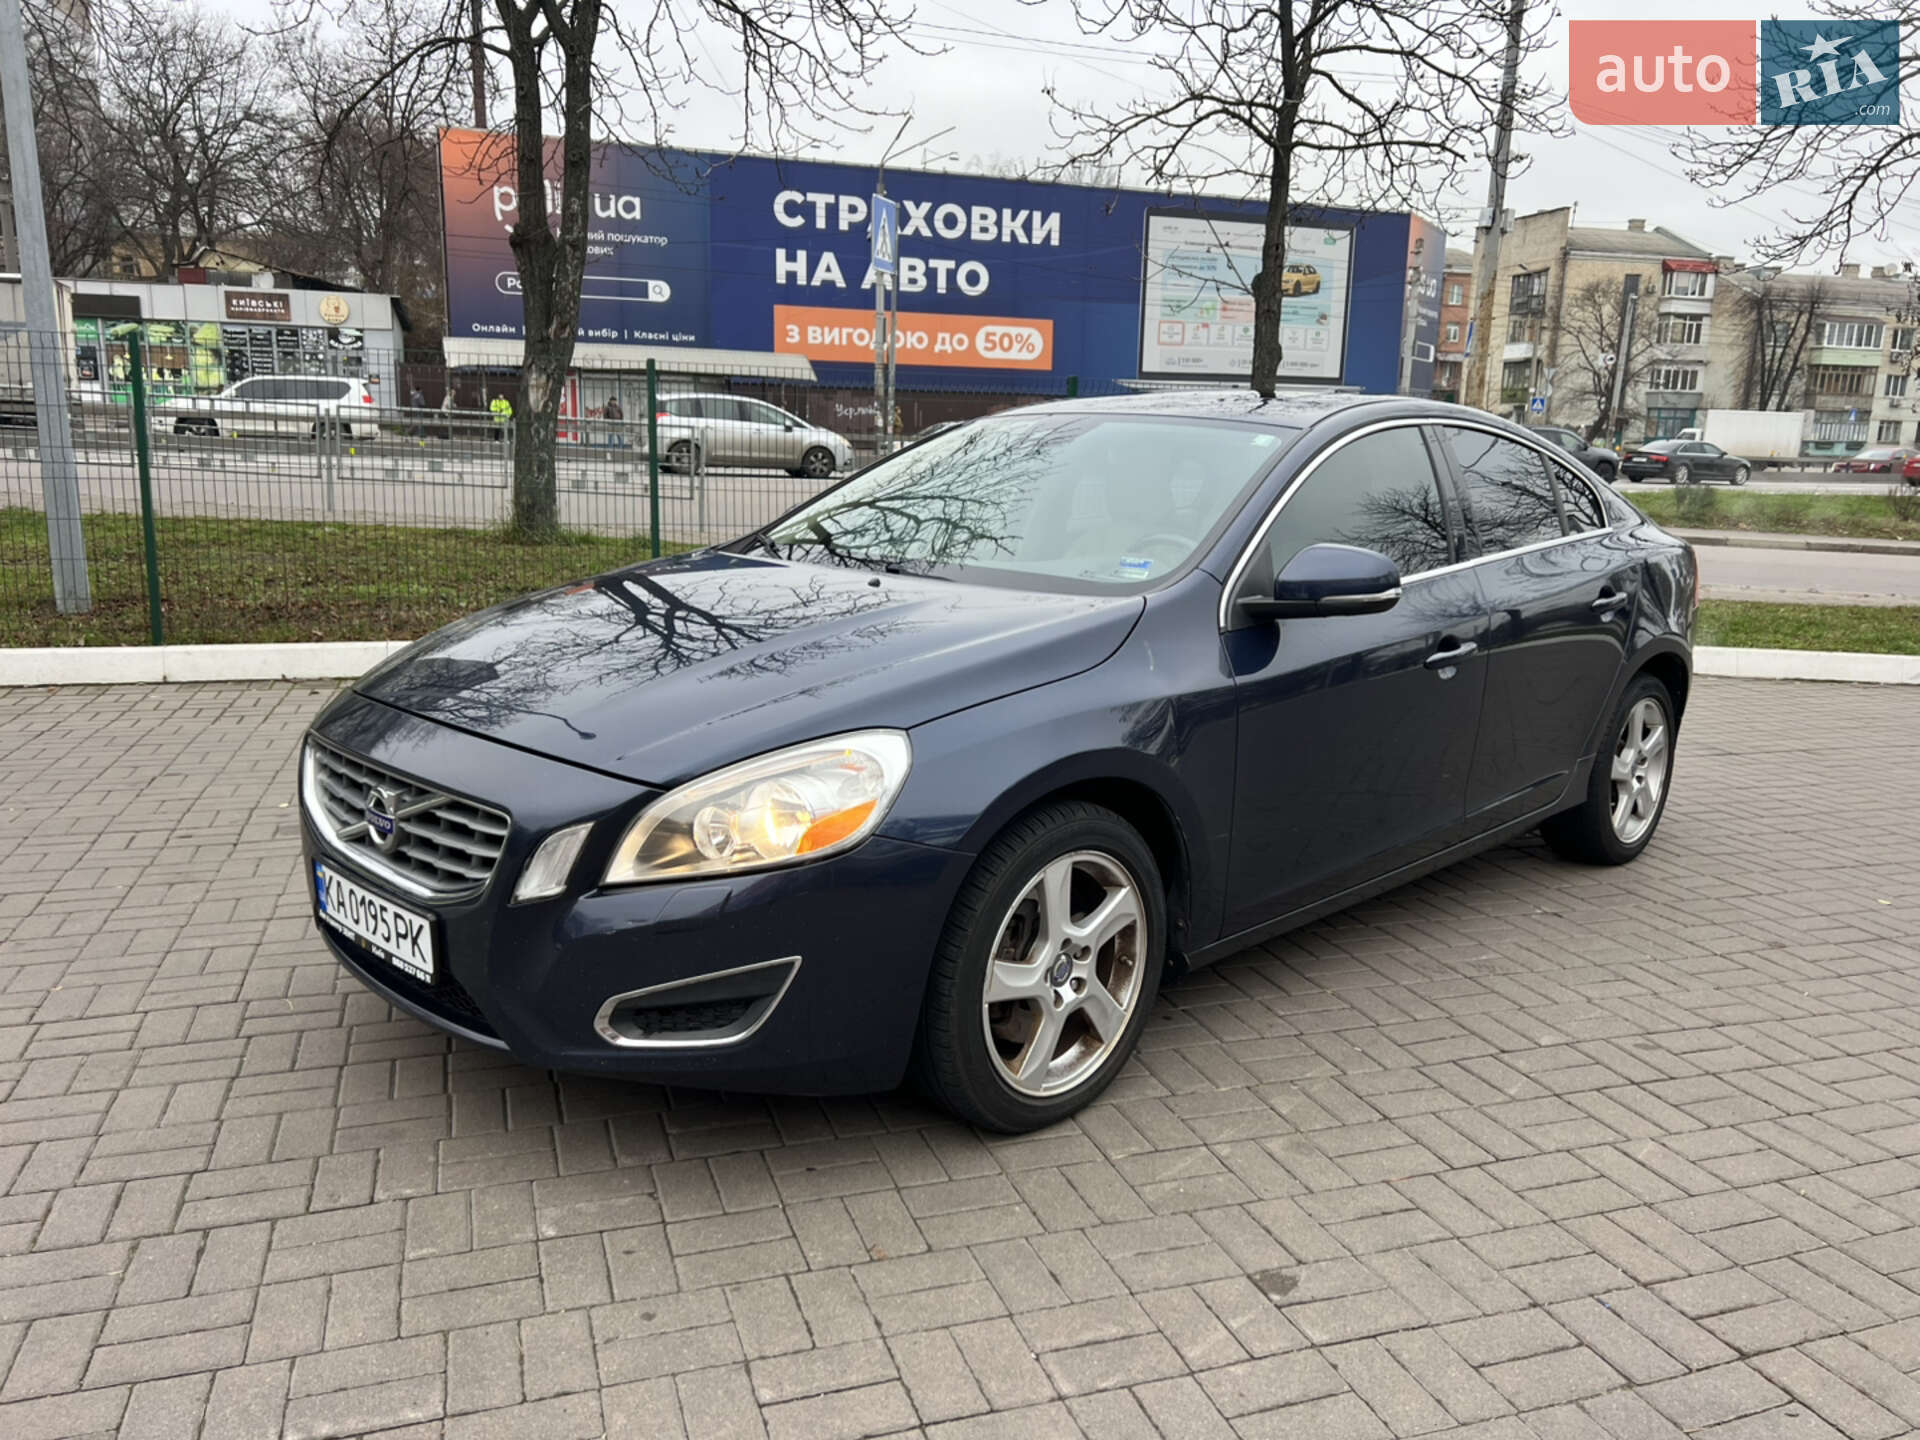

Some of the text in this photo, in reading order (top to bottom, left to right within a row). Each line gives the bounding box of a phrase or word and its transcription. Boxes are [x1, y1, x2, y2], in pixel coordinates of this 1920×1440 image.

[773, 190, 1061, 246] СТРХОВКИ
[607, 232, 668, 247] пошукатор
[775, 248, 847, 288] НА
[472, 323, 516, 333] Онлайн
[588, 328, 618, 339] вибір
[633, 330, 696, 342] Класні ціни
[934, 332, 969, 354] ДО
[983, 332, 1036, 353] 50%
